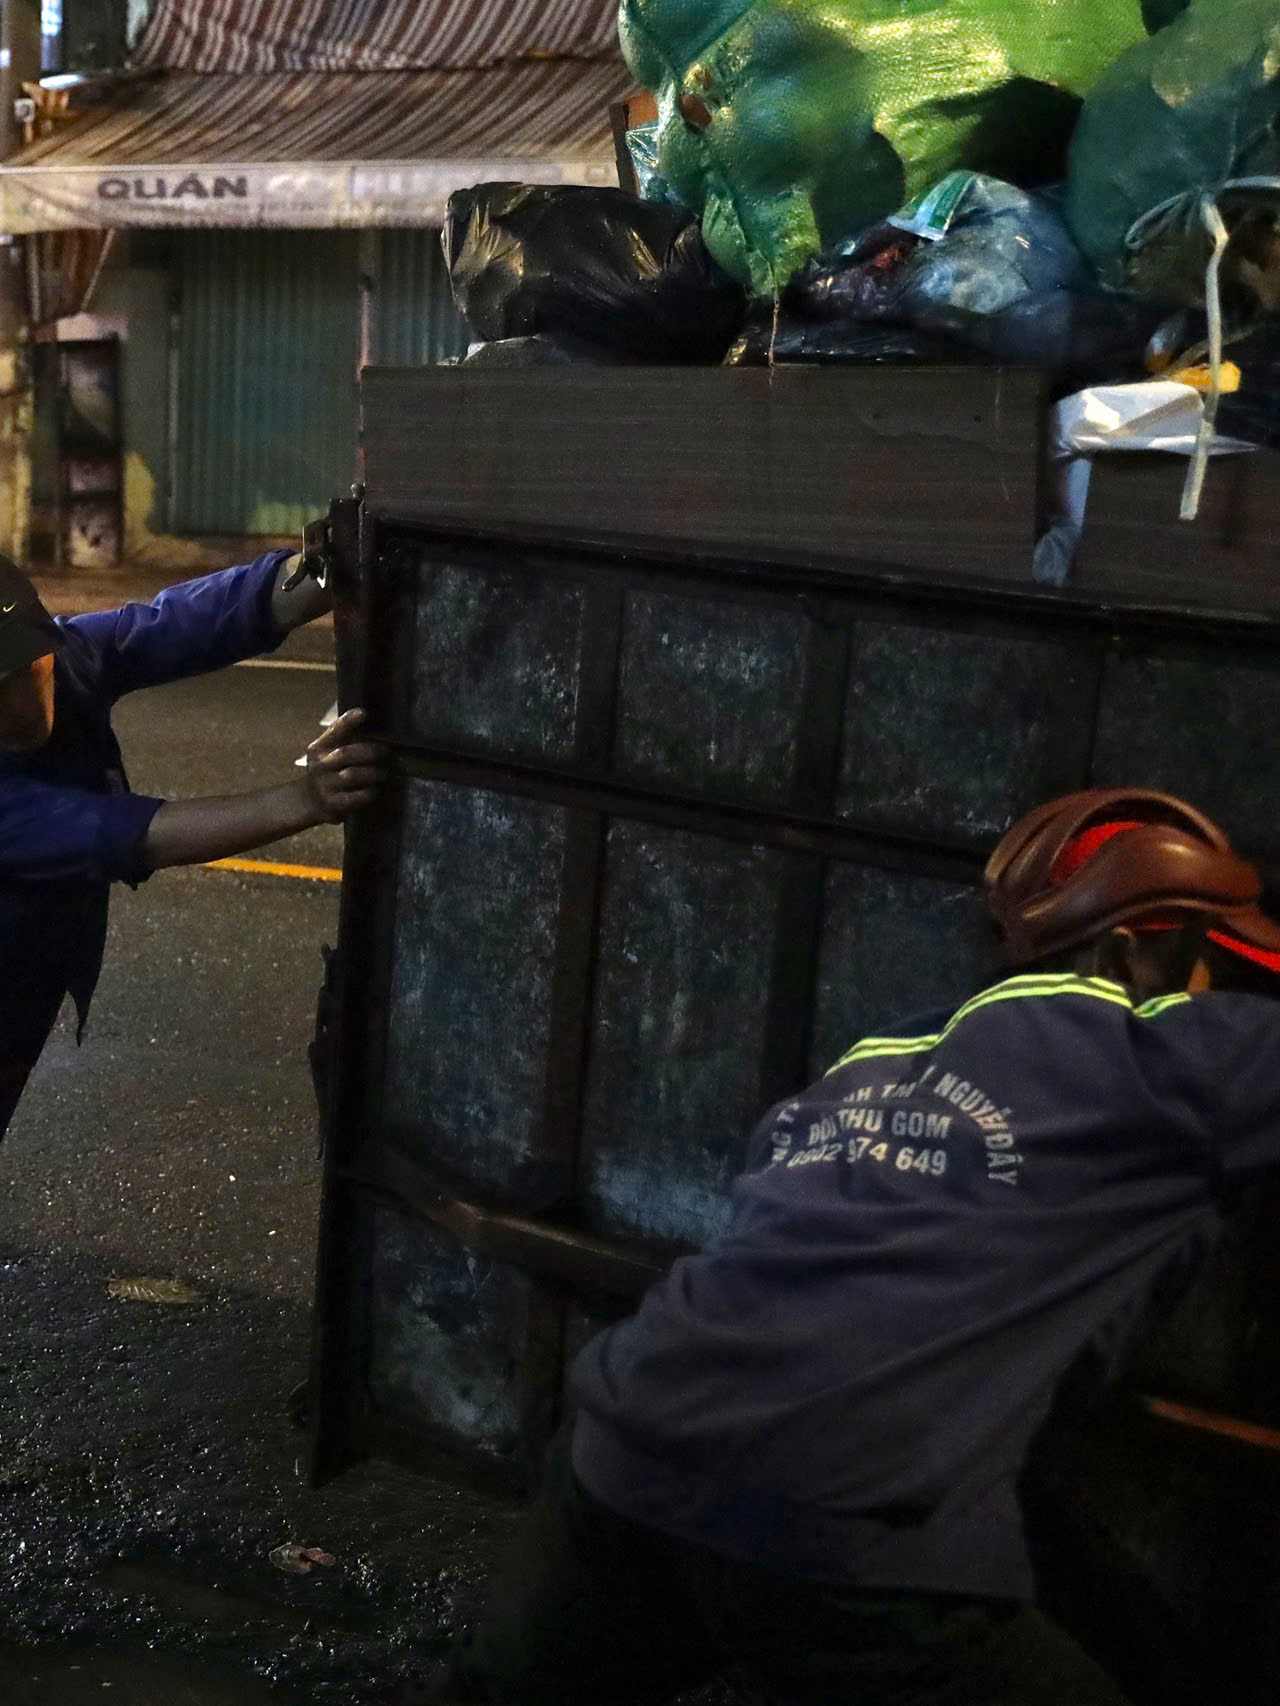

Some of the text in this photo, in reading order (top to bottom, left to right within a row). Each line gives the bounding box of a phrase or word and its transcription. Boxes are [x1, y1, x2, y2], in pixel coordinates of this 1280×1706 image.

[97, 172, 250, 200] QUÁN
[891, 1110, 953, 1140] GOM
[895, 1147, 948, 1176] 649
